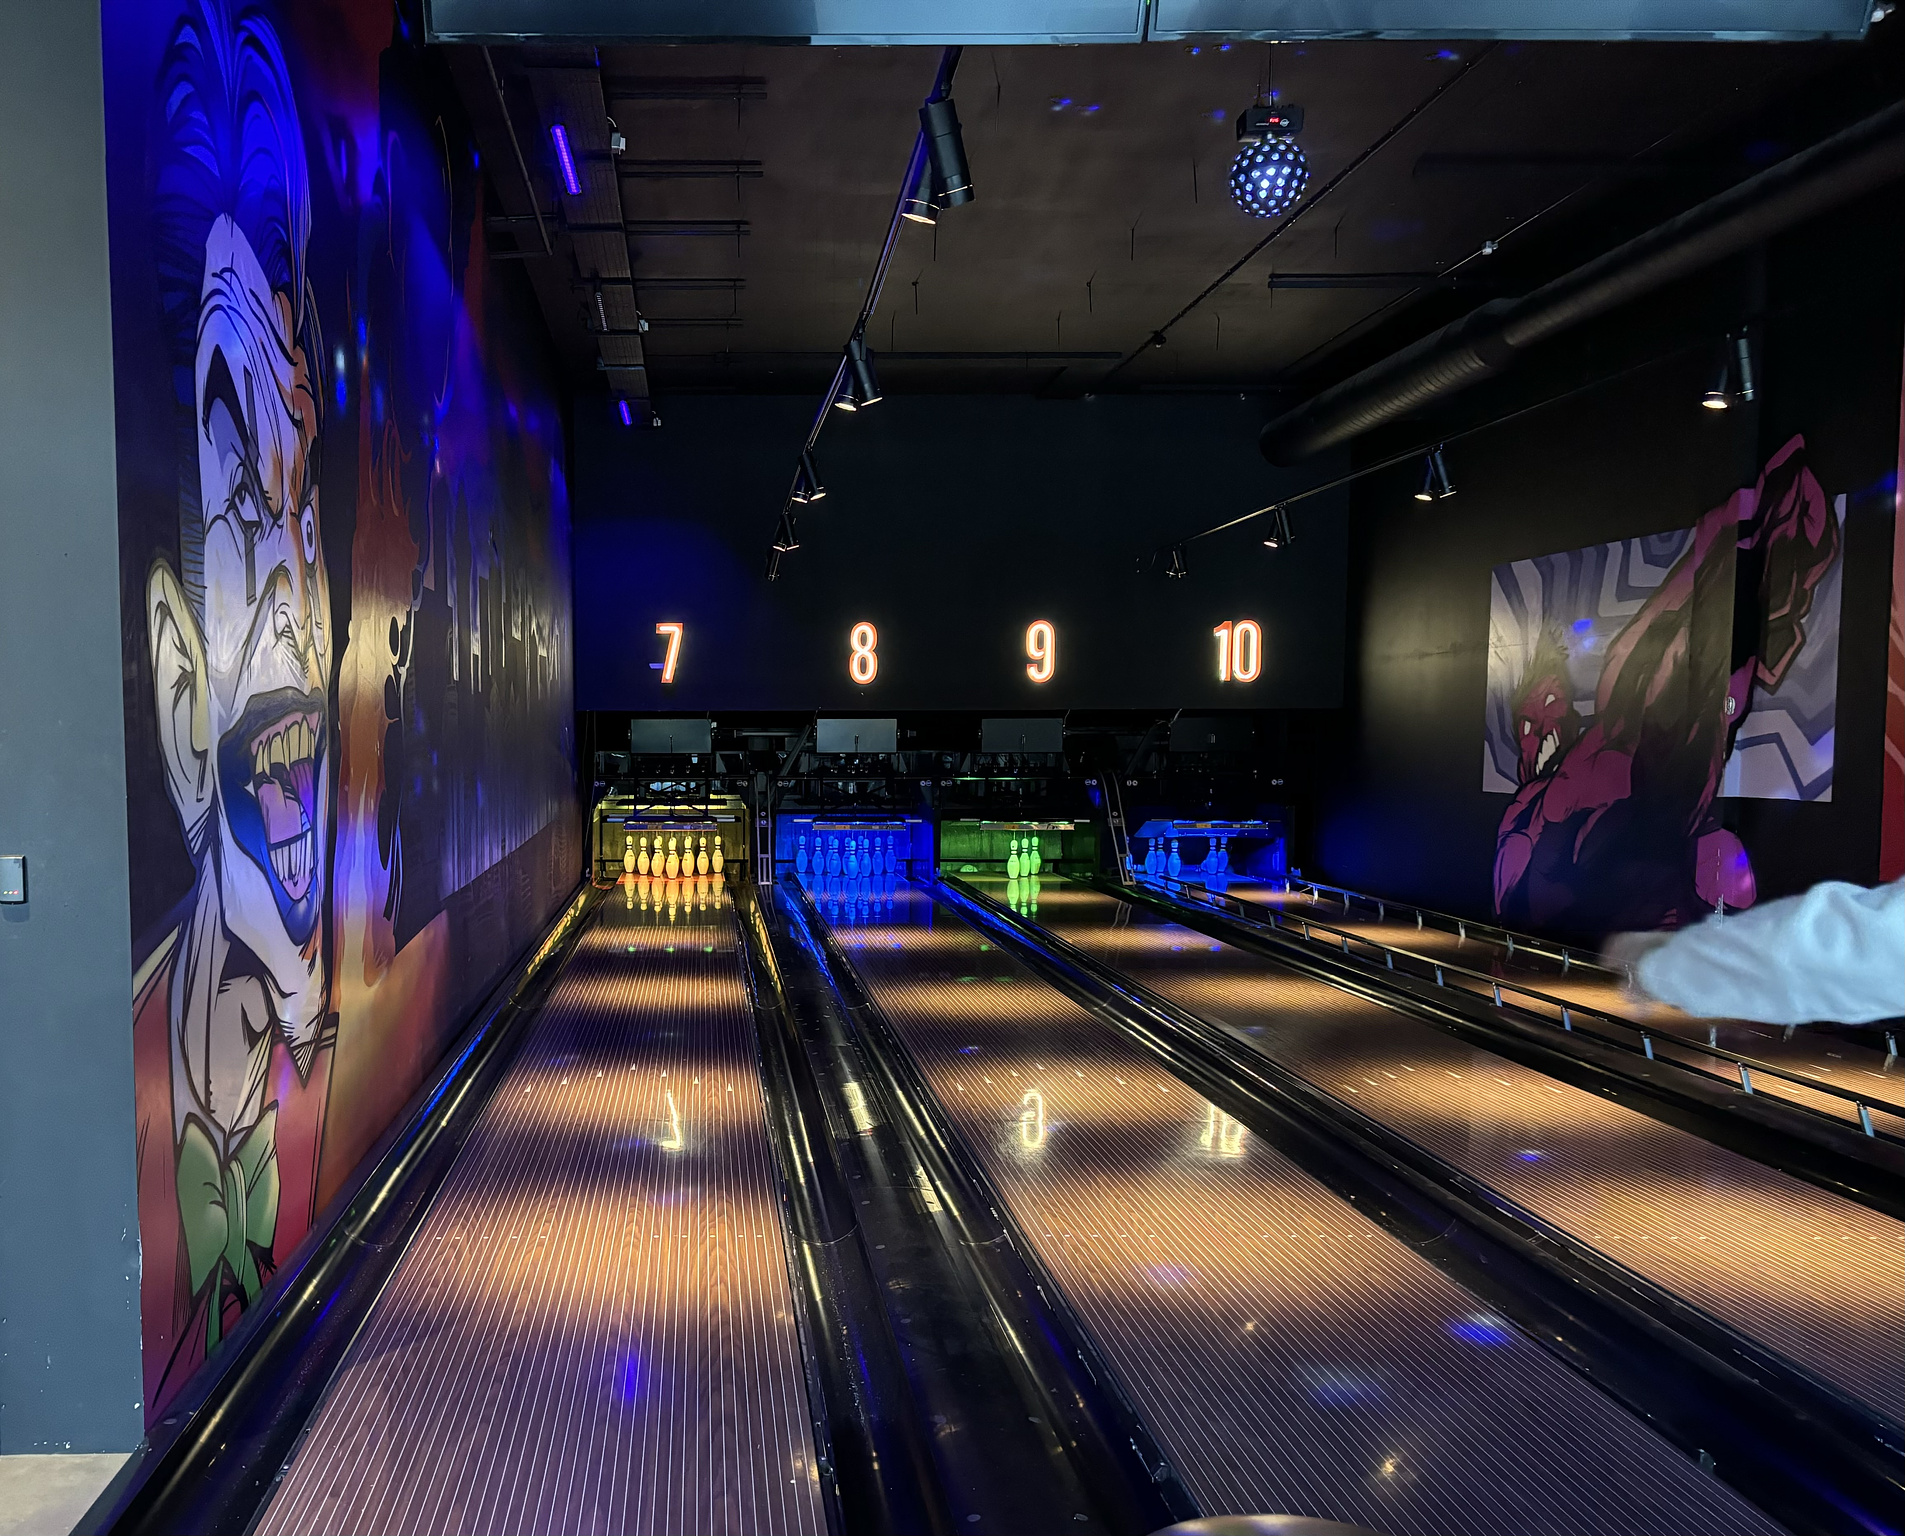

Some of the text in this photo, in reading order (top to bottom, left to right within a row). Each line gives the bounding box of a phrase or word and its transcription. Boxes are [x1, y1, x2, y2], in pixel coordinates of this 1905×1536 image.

[656, 622, 683, 683] 7
[849, 621, 878, 684] 8
[1026, 620, 1055, 683] 9
[1214, 619, 1262, 683] 10
